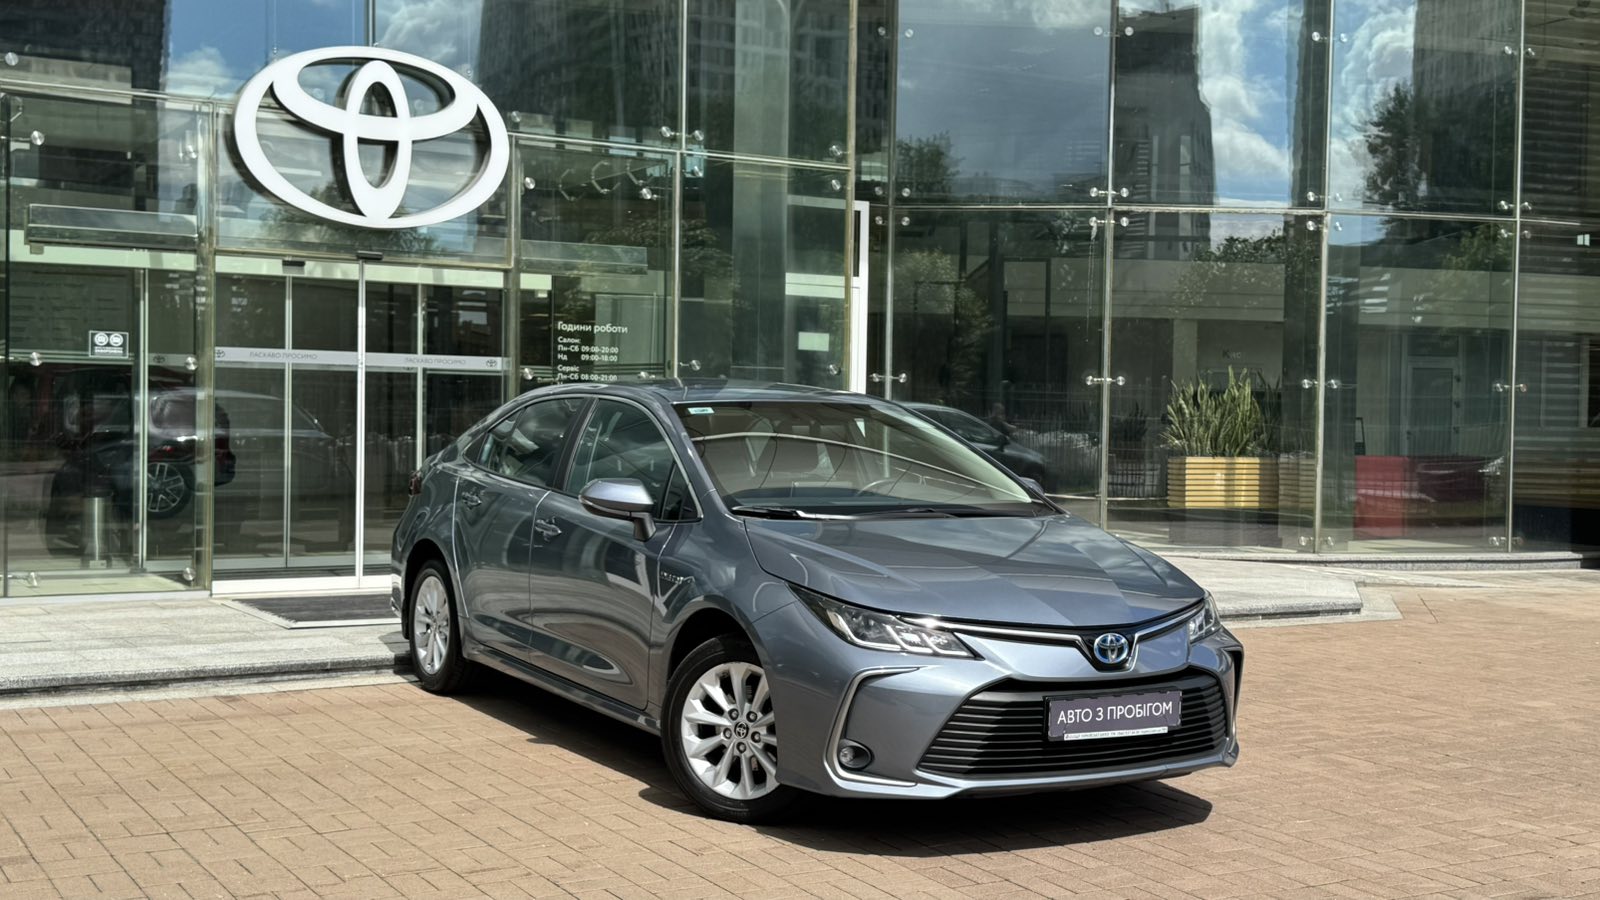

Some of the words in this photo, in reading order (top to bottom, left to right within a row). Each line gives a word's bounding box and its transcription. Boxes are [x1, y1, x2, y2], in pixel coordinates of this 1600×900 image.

[557, 321, 592, 332] Години
[593, 323, 628, 334] роботи
[581, 346, 619, 354] 09:00-20:00
[581, 354, 618, 362] 09:00-18:00
[557, 364, 580, 372] Сервіс
[1057, 708, 1093, 725] АВТО
[1107, 701, 1173, 720] ПРОБІГОМ
